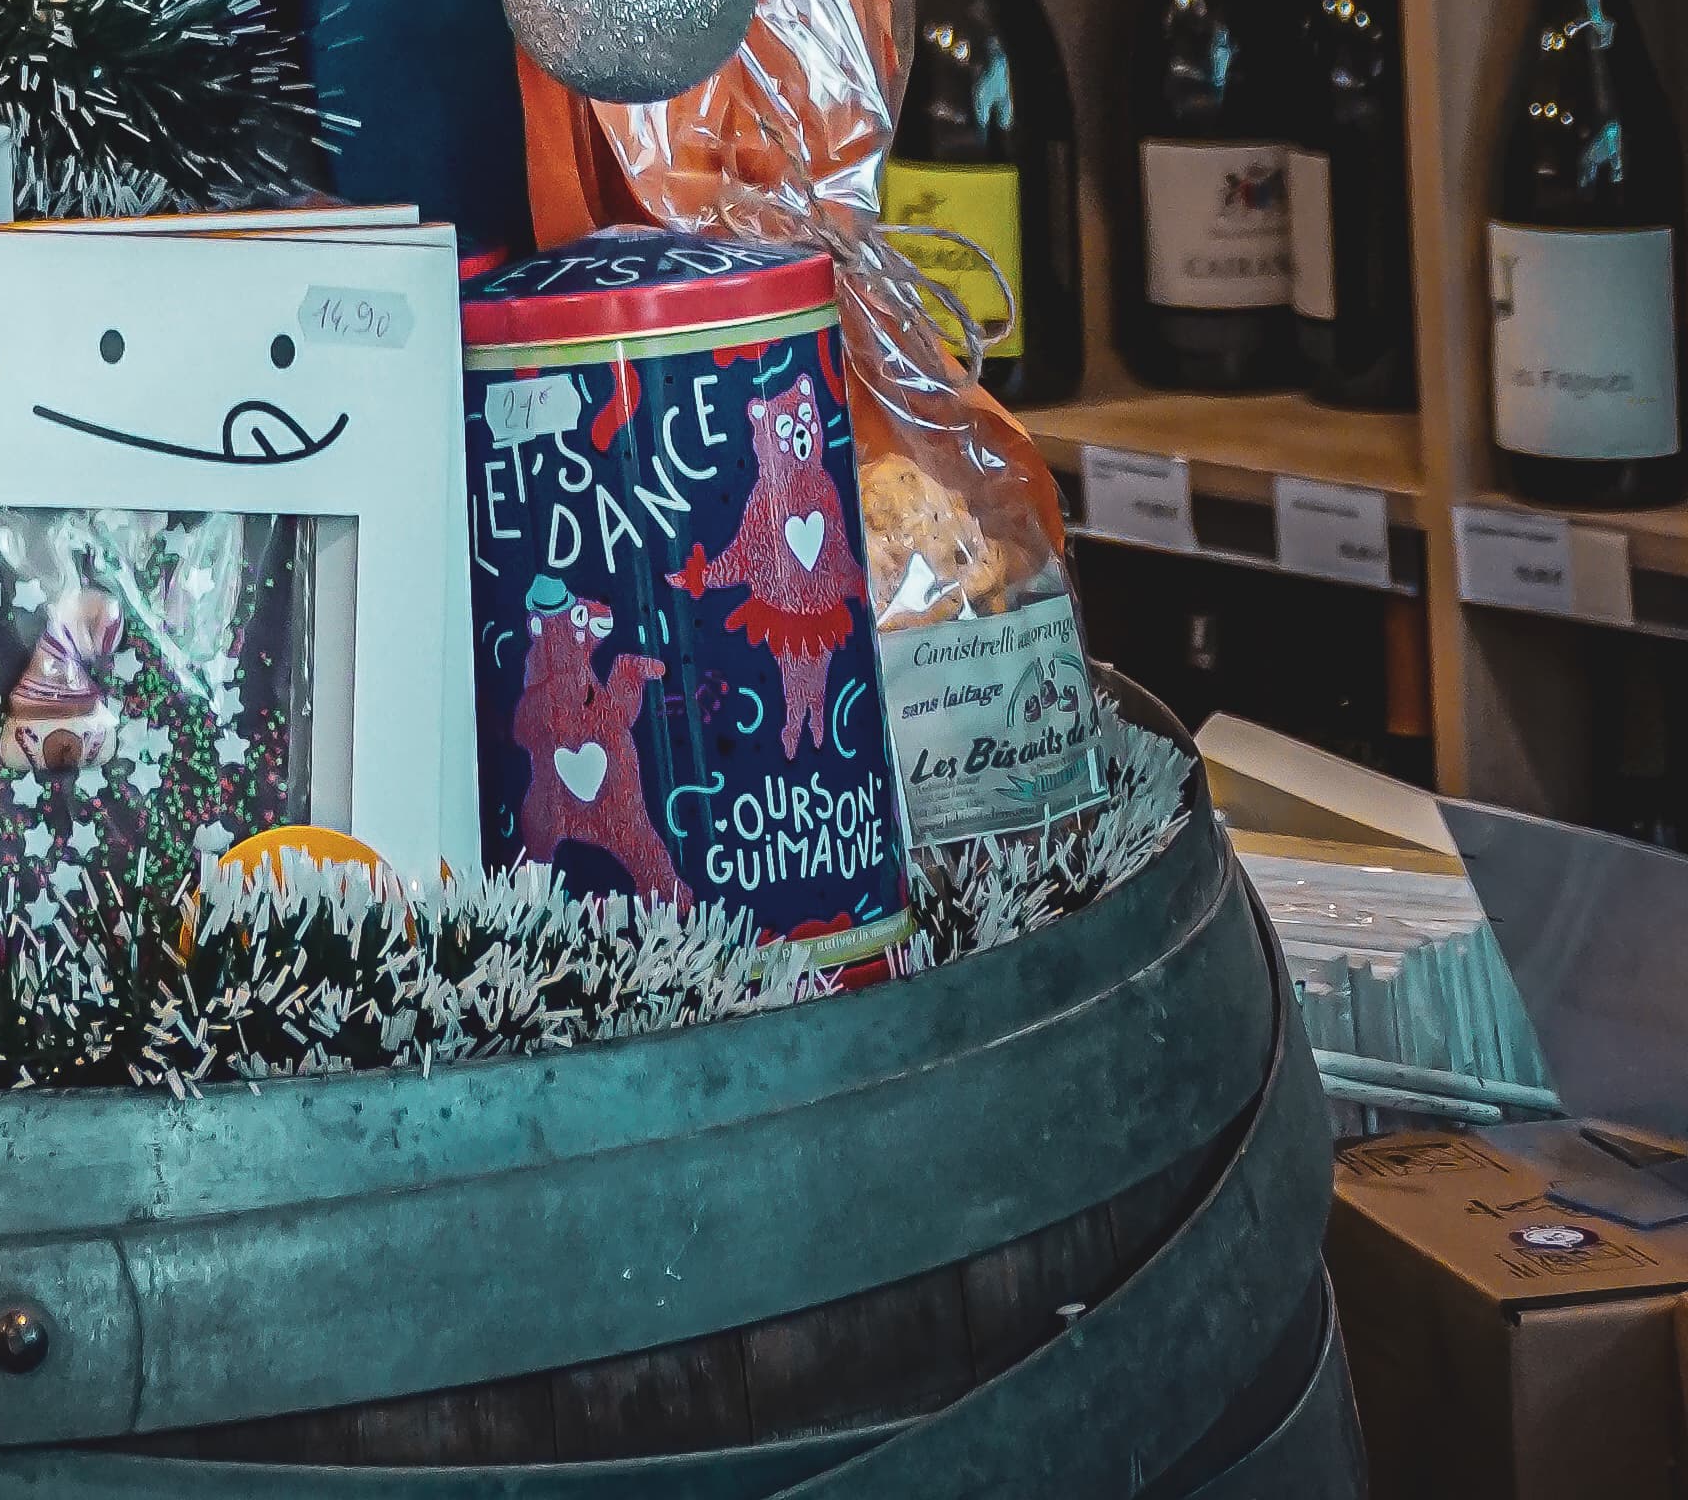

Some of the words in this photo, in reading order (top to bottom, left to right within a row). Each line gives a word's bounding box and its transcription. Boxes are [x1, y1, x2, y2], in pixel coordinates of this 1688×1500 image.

[483, 256, 646, 292] ET'S
[472, 424, 594, 577] LET'S
[548, 374, 729, 574] DANCE
[913, 625, 1015, 667] Canistrelli
[1032, 619, 1074, 644] orang
[901, 700, 938, 721] sans
[943, 683, 1004, 713] laitage
[910, 749, 959, 783] Les
[963, 725, 1063, 776] Biscuits
[733, 769, 878, 841] OURSON
